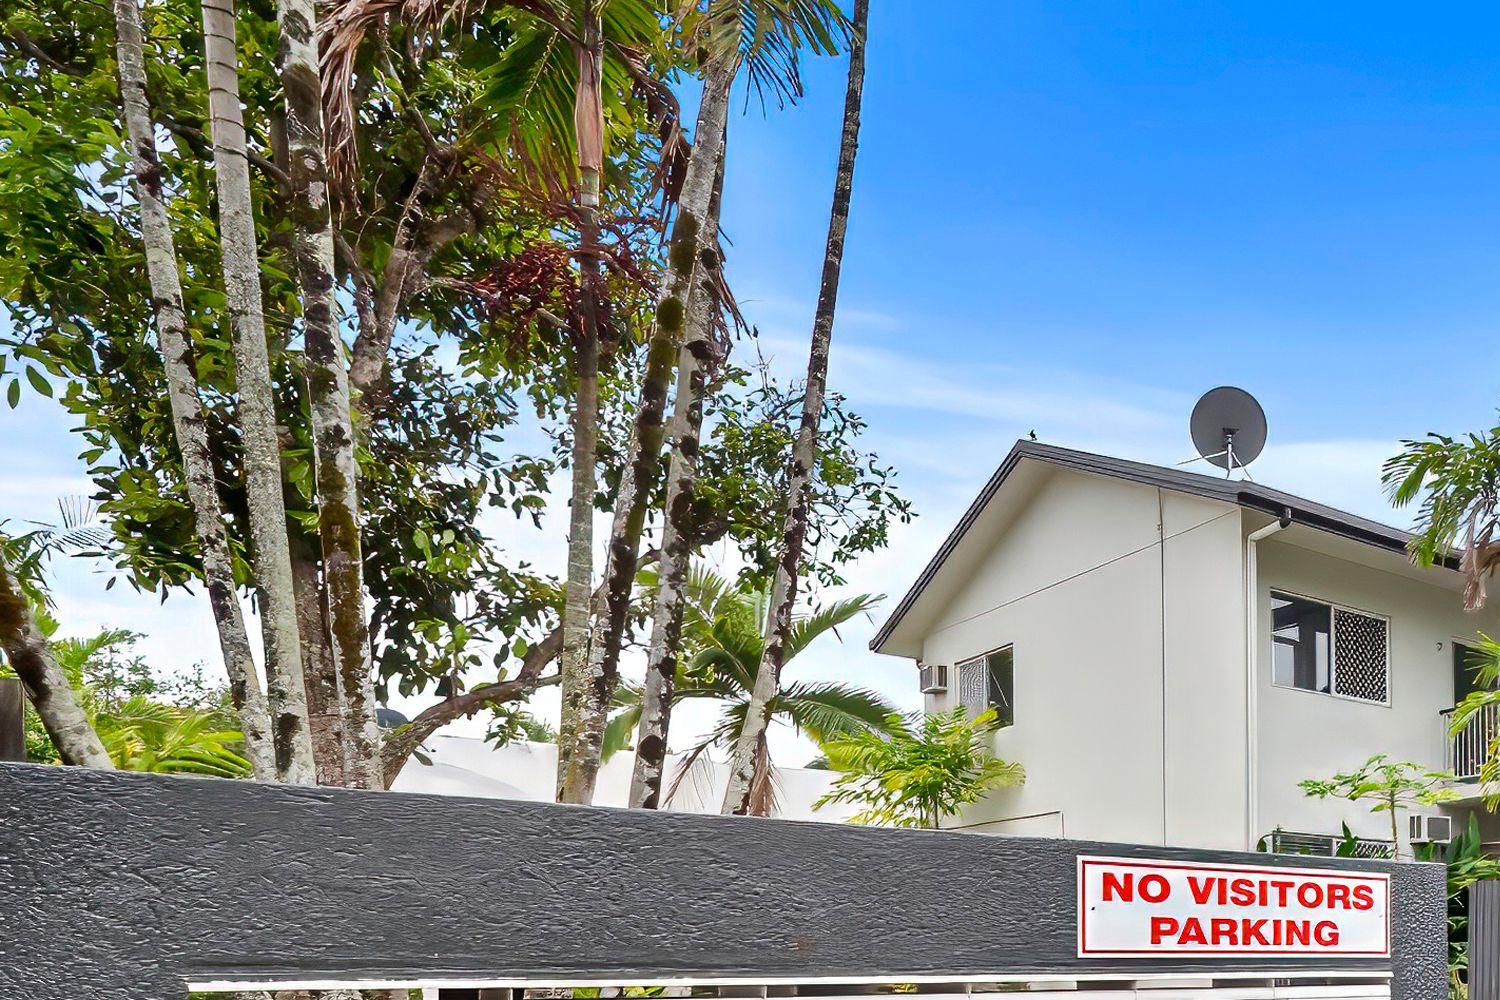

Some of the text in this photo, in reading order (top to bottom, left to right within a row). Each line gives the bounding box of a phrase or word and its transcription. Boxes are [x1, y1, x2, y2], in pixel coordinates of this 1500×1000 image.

[1102, 872, 1375, 911] NO VISITORS
[1150, 916, 1340, 946] PARKING
